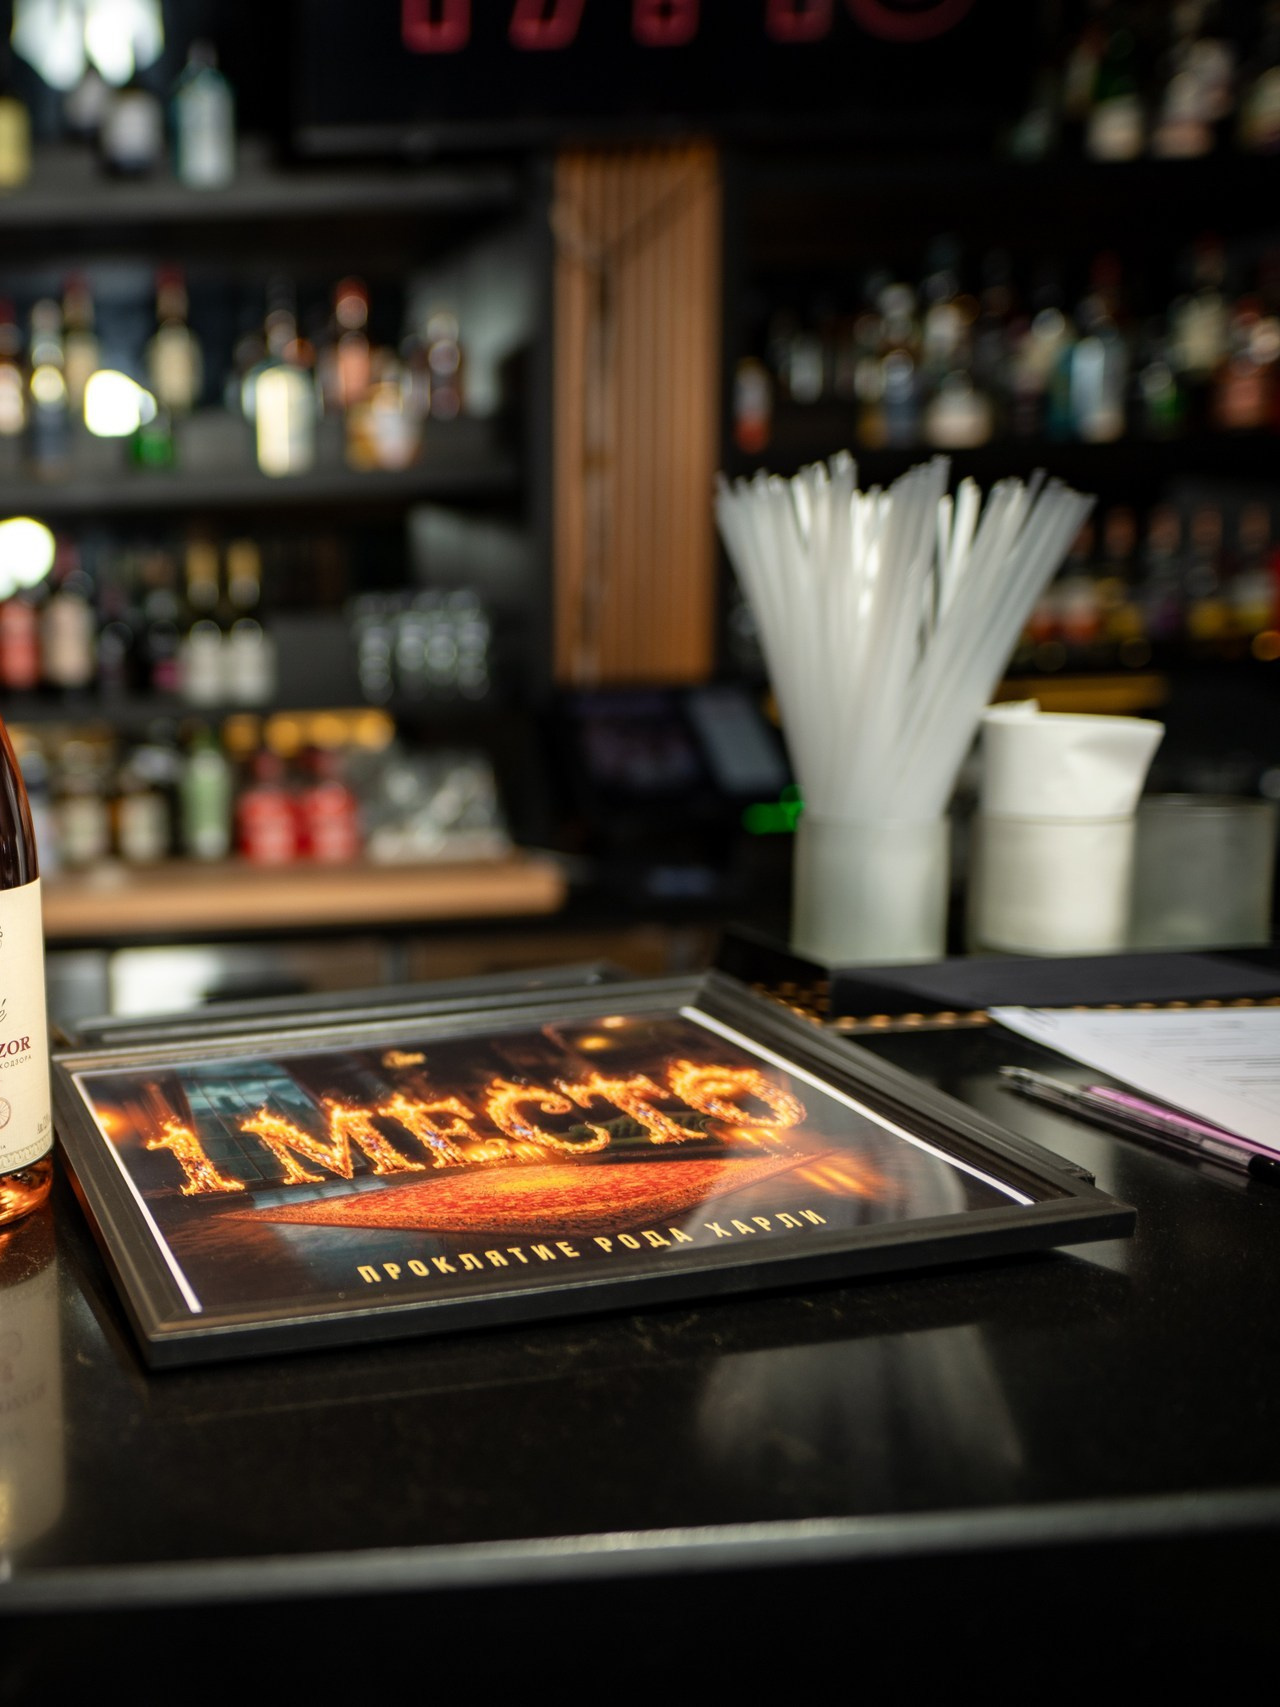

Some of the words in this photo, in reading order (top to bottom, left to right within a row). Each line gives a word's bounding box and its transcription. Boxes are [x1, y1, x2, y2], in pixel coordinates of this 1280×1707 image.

[147, 1121, 245, 1196] 1
[241, 1058, 808, 1184] МЕСТО
[357, 1241, 580, 1283] ПРОКЛЯТИЕ
[594, 1227, 693, 1253] РОДА
[704, 1209, 827, 1239] ХАРЛИ
